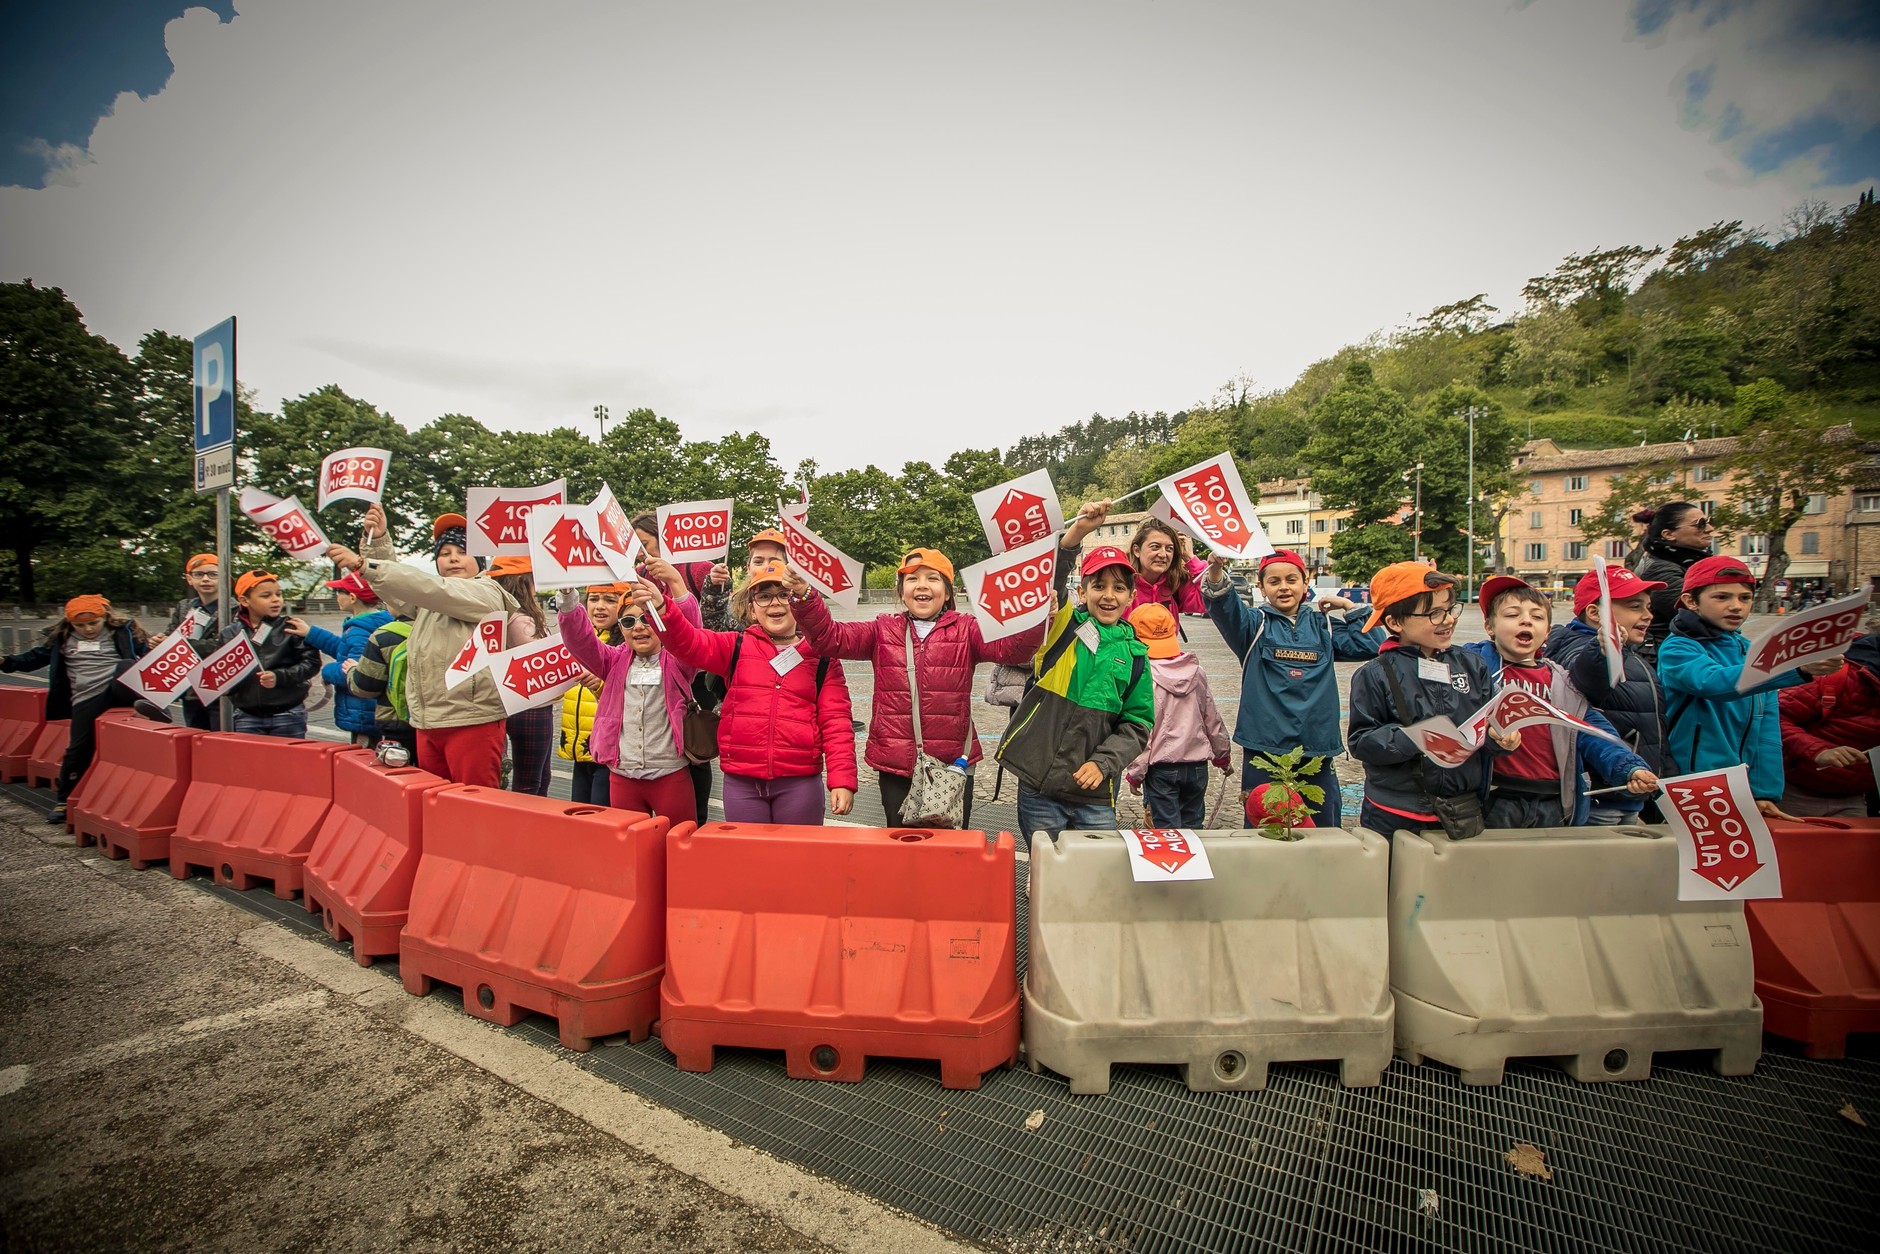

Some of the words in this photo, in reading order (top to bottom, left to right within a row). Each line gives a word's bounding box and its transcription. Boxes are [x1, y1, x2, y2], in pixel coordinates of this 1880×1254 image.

[202, 341, 224, 436] P
[331, 459, 375, 474] 1000
[328, 475, 377, 493] MIGLIA
[1179, 481, 1222, 539] MIGLIA
[1204, 475, 1240, 532] 1000
[674, 514, 722, 531] 1000
[673, 532, 726, 549] MIGLIA
[785, 525, 833, 567] 1000
[784, 538, 834, 587] MIGLIA
[995, 557, 1053, 592] 1000
[1000, 577, 1053, 617] MIGLI
[1778, 613, 1857, 645] 1000
[151, 644, 188, 675] 1000
[210, 645, 245, 673] 1000
[522, 646, 571, 673] 1000
[1772, 627, 1857, 666] MIGLIA
[214, 653, 252, 687] MIGLIA
[526, 661, 581, 693] MIGLIA
[1671, 787, 1722, 867] MIGLIA
[1702, 785, 1750, 859] 1000
